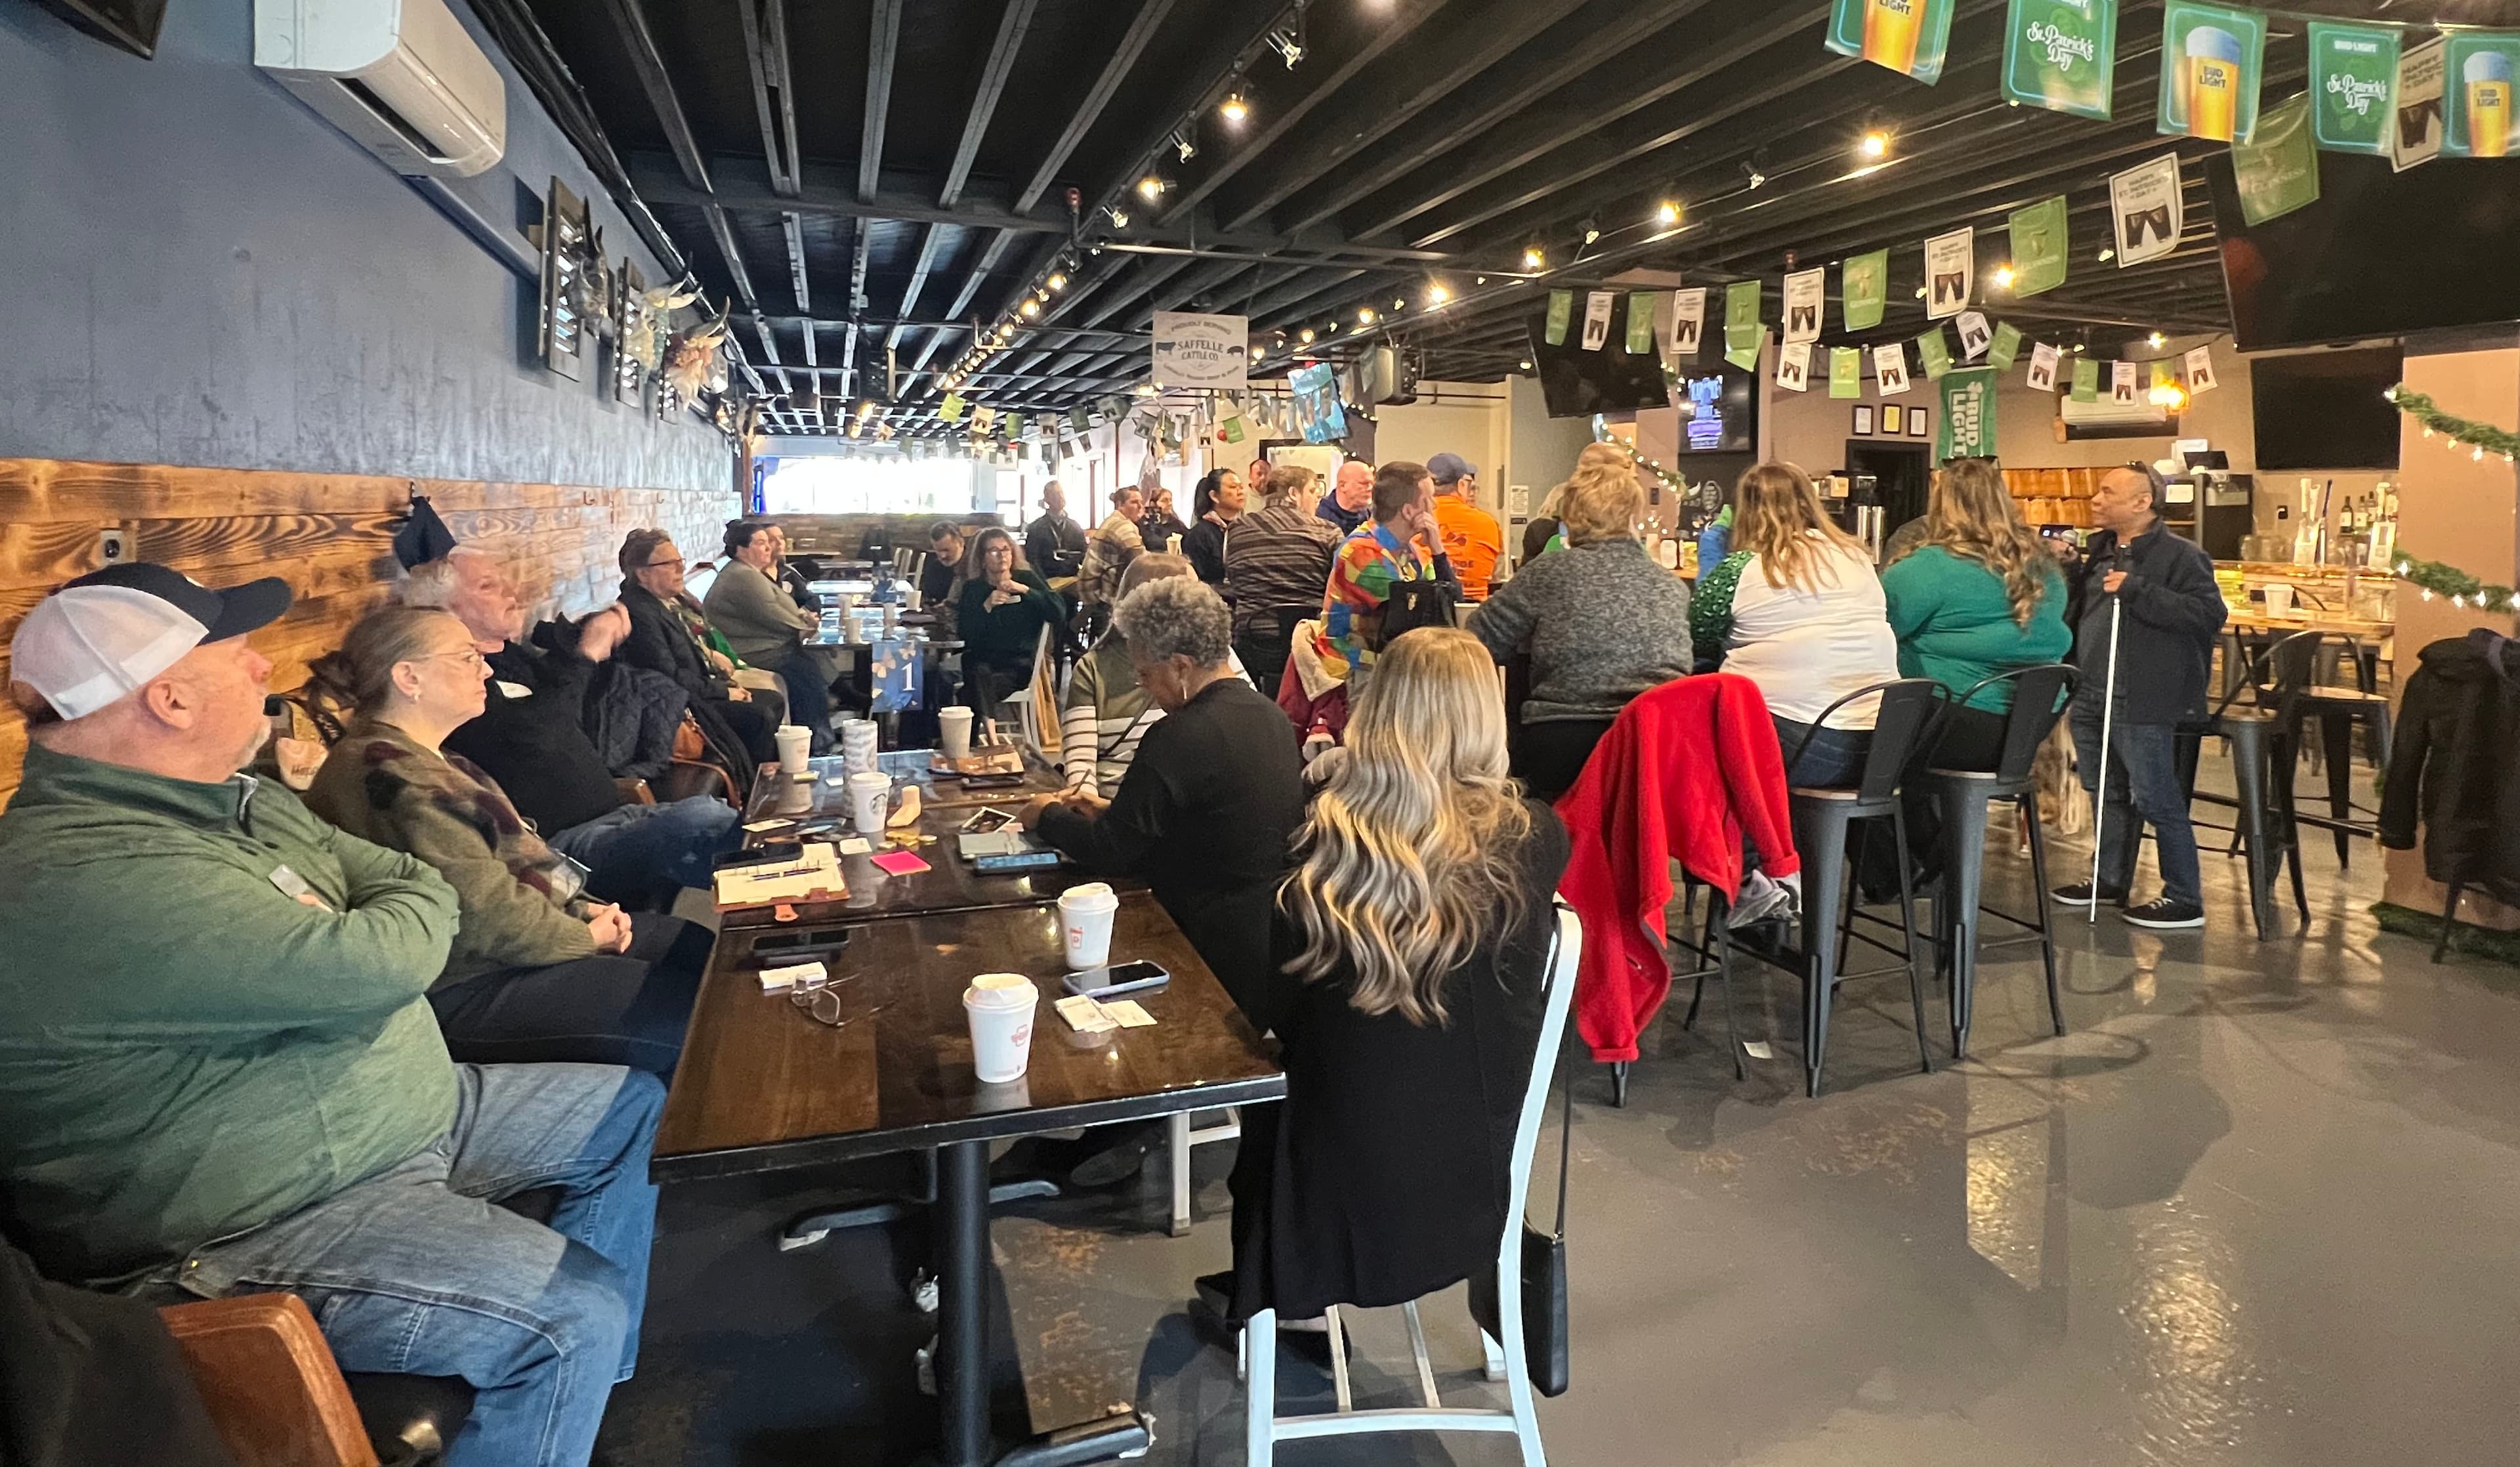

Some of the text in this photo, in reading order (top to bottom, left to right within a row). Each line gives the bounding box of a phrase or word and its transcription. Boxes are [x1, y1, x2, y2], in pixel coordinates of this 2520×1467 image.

[2044, 24, 2094, 62] Patrick's
[2047, 43, 2074, 72] Day
[2199, 75, 2226, 89] LIGHT
[2204, 66, 2223, 77] BUD
[2345, 91, 2370, 116] Day
[1177, 339, 1224, 354] SAFFELLE
[1952, 393, 1967, 456] LIGHT
[1965, 401, 1979, 447] BUD
[886, 578, 896, 593] 2
[901, 662, 917, 691] 1
